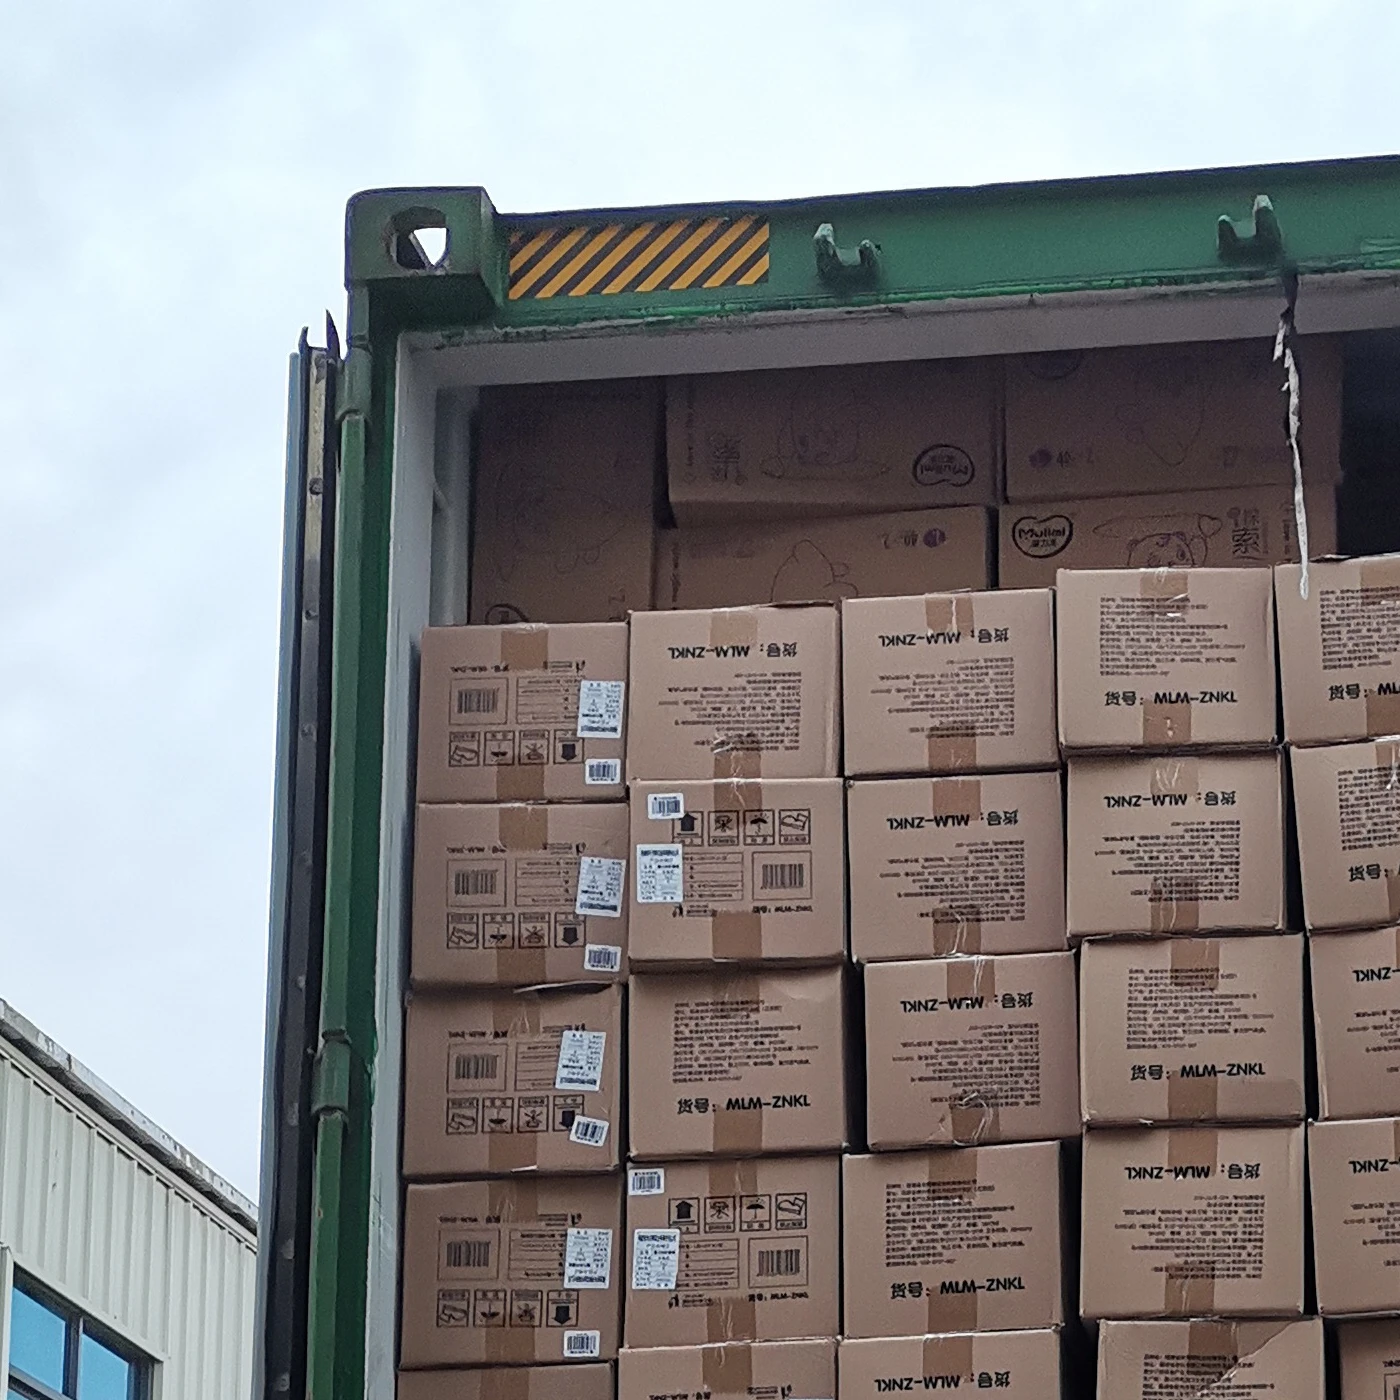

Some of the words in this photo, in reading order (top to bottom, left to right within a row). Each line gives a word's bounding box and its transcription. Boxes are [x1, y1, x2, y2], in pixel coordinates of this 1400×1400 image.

[877, 628, 962, 648] MLM-ZNKL
[667, 644, 751, 660] MLM-ZNKL
[1153, 690, 1238, 706] MLM-ZNKL
[1103, 792, 1188, 809] MLM-ZNKL
[885, 813, 971, 831] MLM-ZNKL
[1179, 1062, 1267, 1079] MLM-ZNKL
[725, 1094, 812, 1112] MLM-ZNKL
[1123, 1165, 1211, 1181] MLM-ZNKL
[939, 1275, 1026, 1296] MLM-ZNKL
[873, 1374, 961, 1393] MLM-ZNKL
